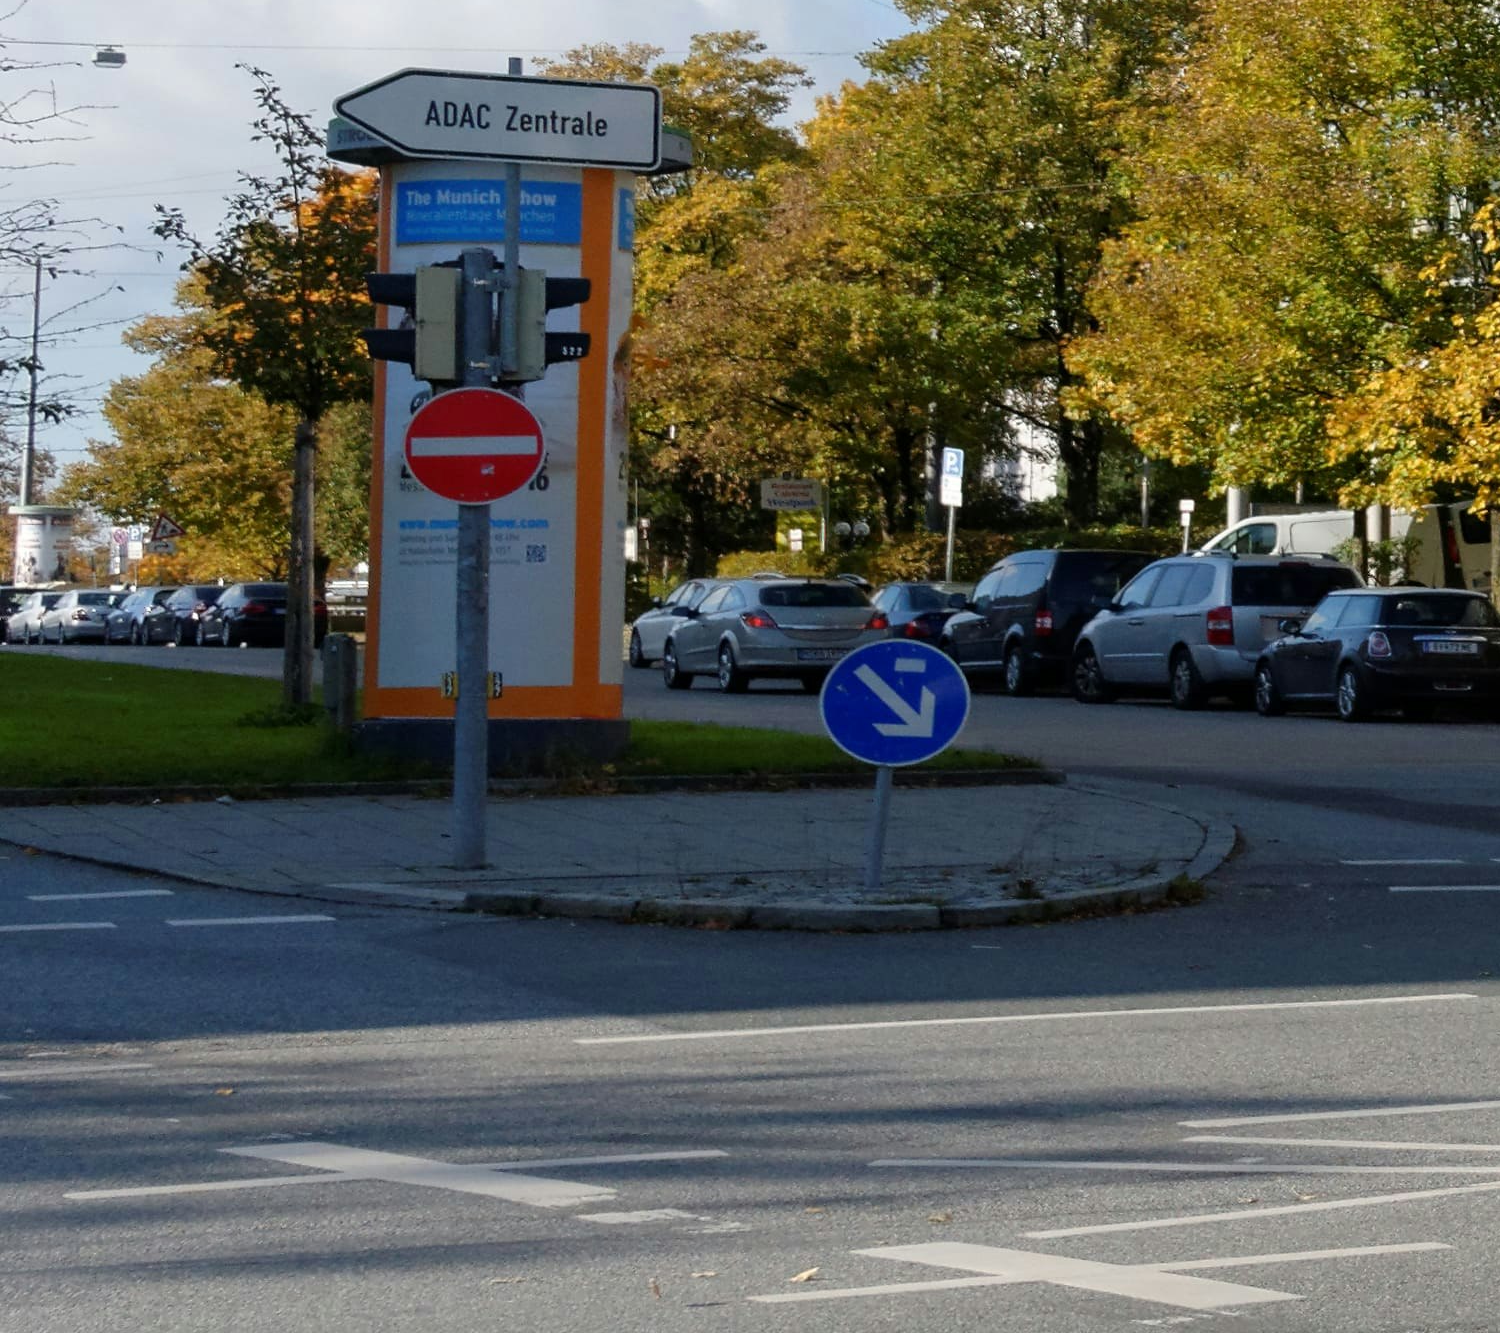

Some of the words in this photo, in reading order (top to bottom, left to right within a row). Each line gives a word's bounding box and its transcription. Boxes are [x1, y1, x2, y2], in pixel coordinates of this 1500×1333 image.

[425, 101, 491, 130] ADAC
[505, 105, 608, 137] Zentrale
[406, 191, 431, 206] The
[437, 189, 500, 206] Munich
[519, 190, 557, 206] how
